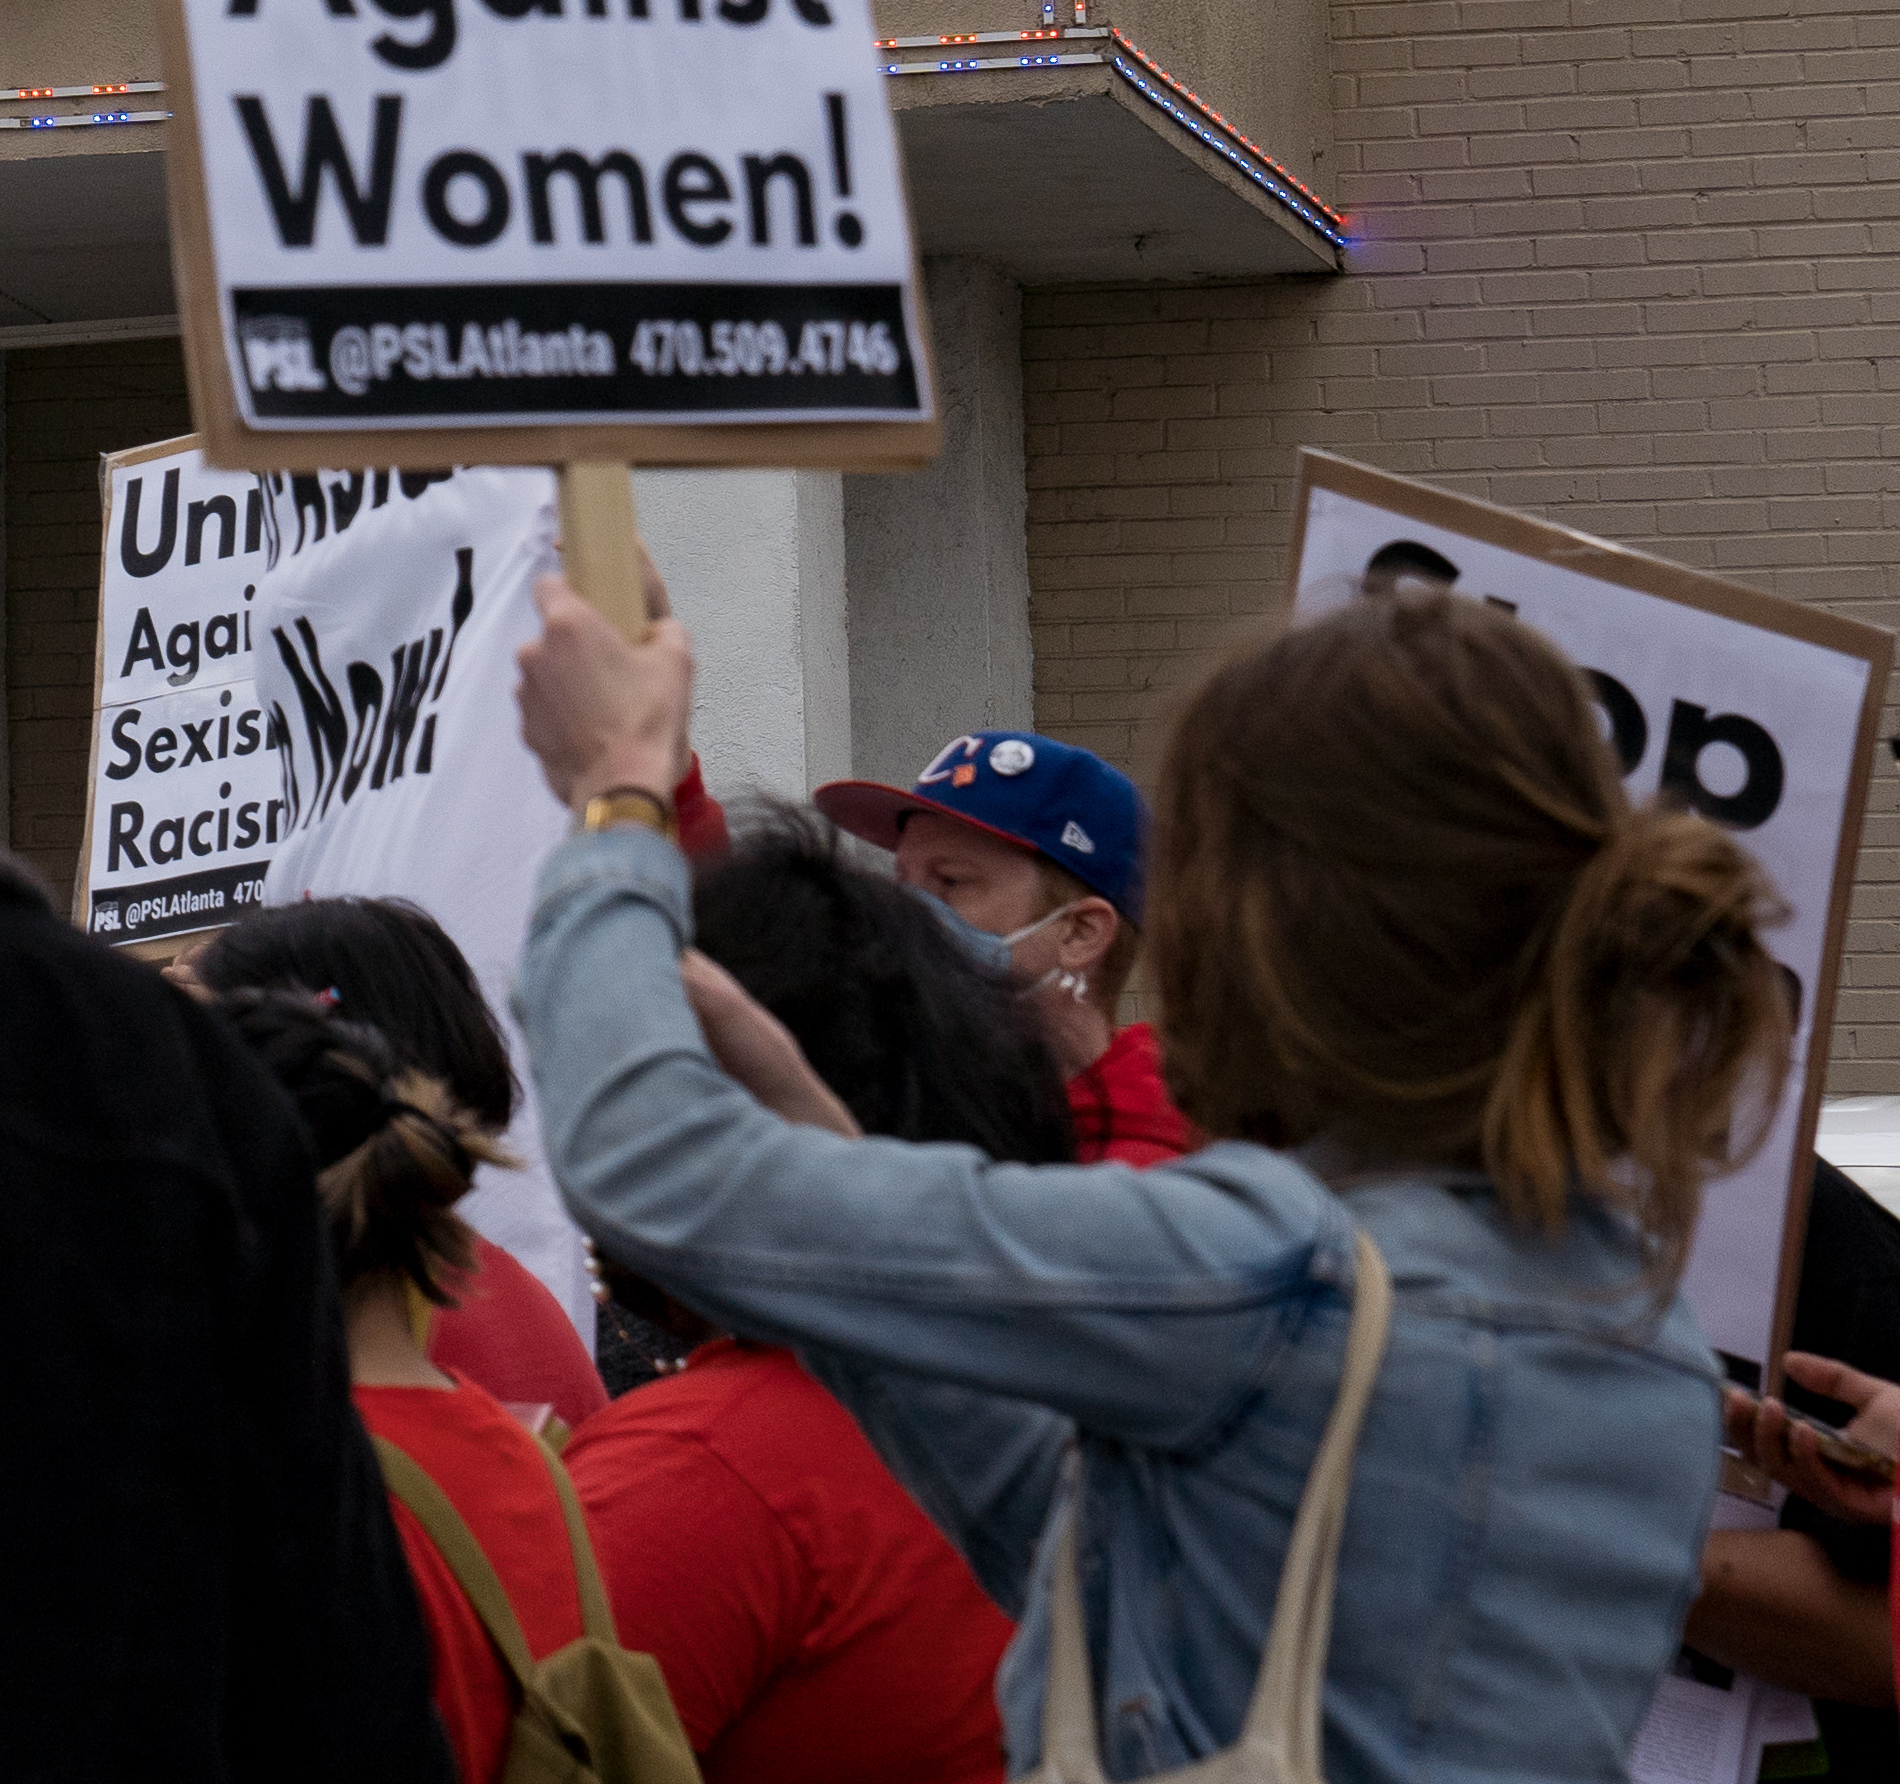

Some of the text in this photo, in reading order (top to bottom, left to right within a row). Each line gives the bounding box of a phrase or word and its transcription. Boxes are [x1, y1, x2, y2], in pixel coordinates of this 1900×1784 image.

[232, 90, 867, 251] Women!
[329, 317, 615, 395] @PSLAtlanta
[630, 321, 900, 376] 470.509.4746
[104, 689, 276, 780] Sexis
[126, 889, 225, 929] @PSLAtlanta
